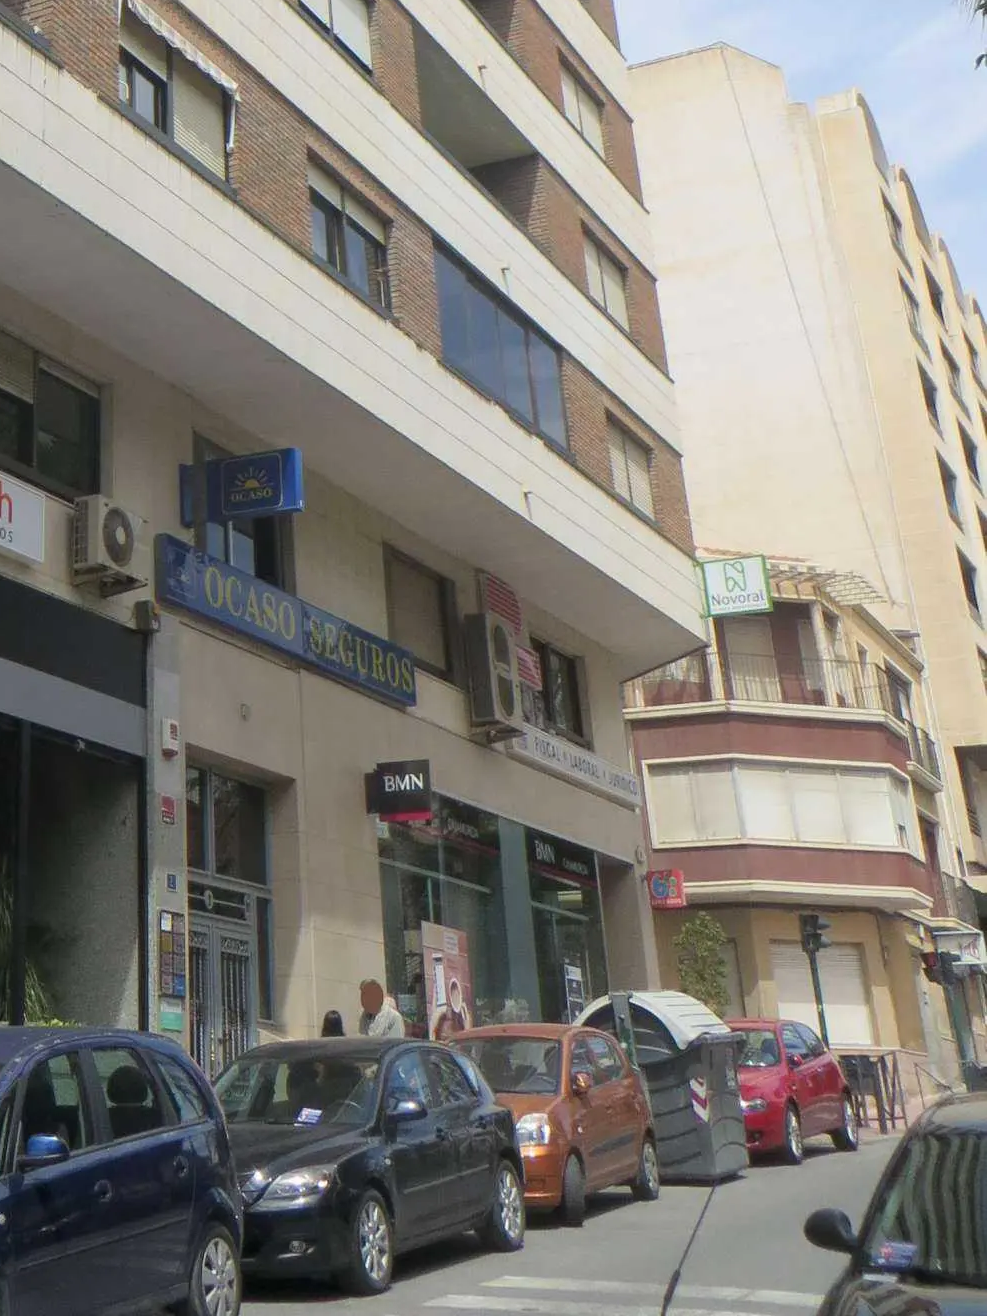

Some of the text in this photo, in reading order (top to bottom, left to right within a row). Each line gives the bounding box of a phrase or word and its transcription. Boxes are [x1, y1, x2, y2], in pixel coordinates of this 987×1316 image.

[230, 487, 273, 502] OCASO
[711, 589, 766, 605] Novoral
[203, 566, 414, 694] OCASO SEGUROS
[382, 773, 424, 793] BMN
